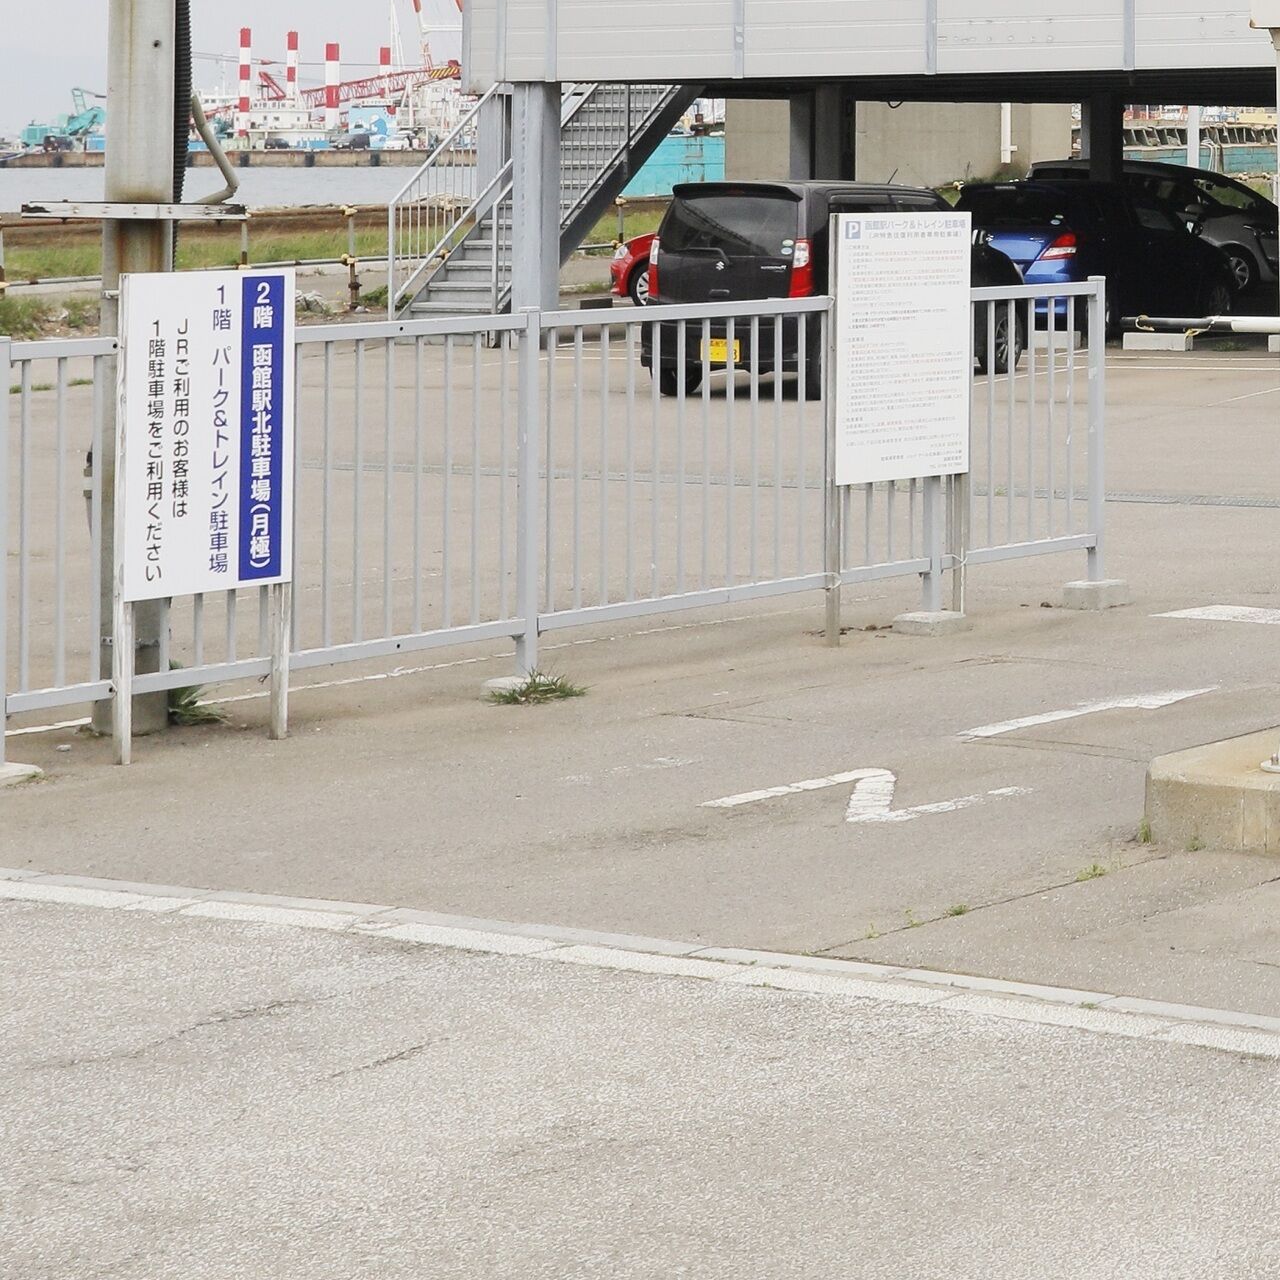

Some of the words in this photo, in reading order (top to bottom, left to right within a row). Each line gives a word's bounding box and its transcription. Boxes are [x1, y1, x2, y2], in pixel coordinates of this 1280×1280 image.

[212, 284, 233, 331] 1階
[252, 282, 274, 329] 2階
[145, 320, 166, 582] 1階駐車場をご利用ください
[171, 318, 190, 518] JRご利用のお客様は
[208, 346, 232, 574] パーク&トレイン駐車場
